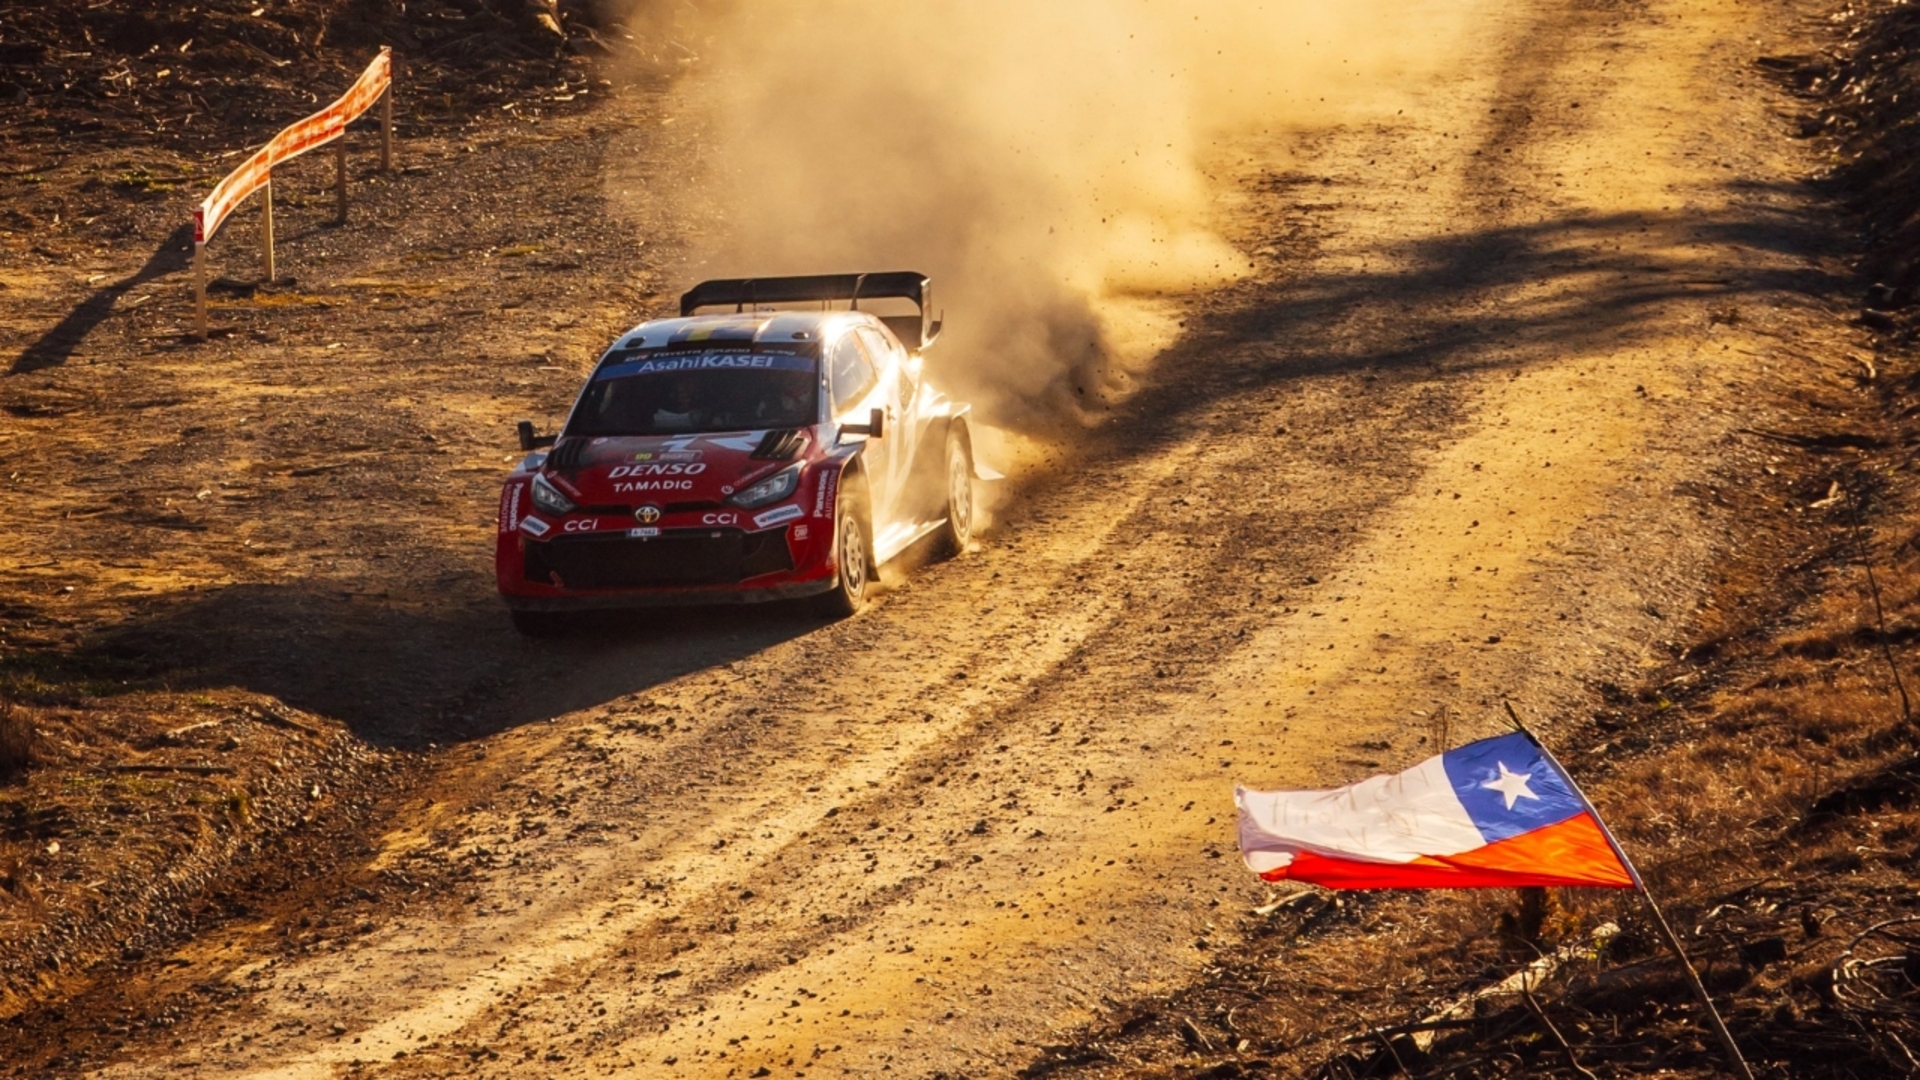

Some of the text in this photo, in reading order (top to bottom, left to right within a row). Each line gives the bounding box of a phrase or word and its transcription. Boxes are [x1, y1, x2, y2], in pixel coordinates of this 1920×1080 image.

[652, 349, 702, 358] TOYOTA
[638, 354, 774, 373] AsahiKASEI
[607, 462, 707, 479] DENSO
[613, 480, 693, 493] TAMADIC
[812, 468, 830, 518] Panasonic
[509, 482, 524, 531] Panasonic
[563, 518, 599, 532] CCI
[702, 513, 738, 525] CCI
